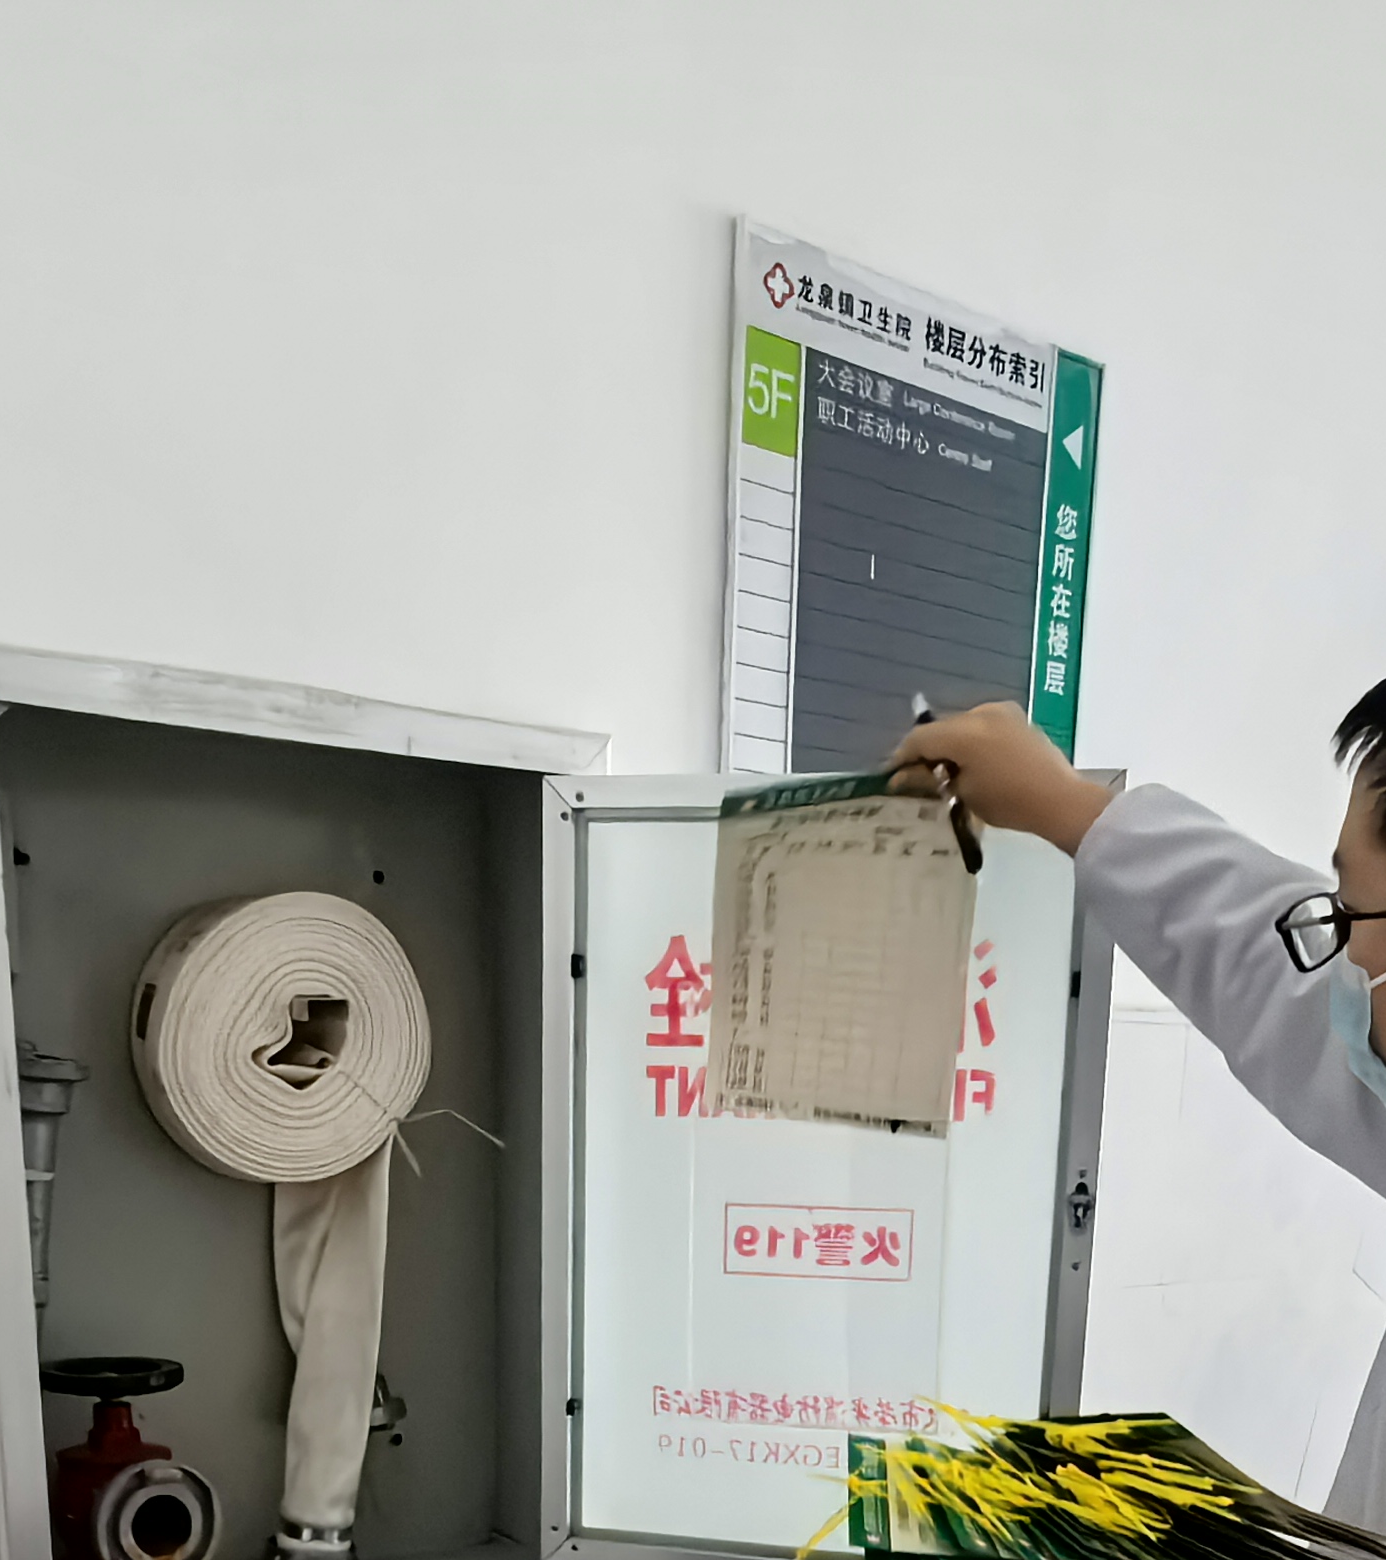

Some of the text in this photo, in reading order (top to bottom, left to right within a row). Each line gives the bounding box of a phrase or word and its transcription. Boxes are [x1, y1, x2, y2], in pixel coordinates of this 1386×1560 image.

[924, 315, 1046, 394] 楼层分布索引
[747, 362, 796, 419] 5F
[817, 395, 931, 456] 职工活动中心
[1043, 503, 1078, 696] 您所在楼层
